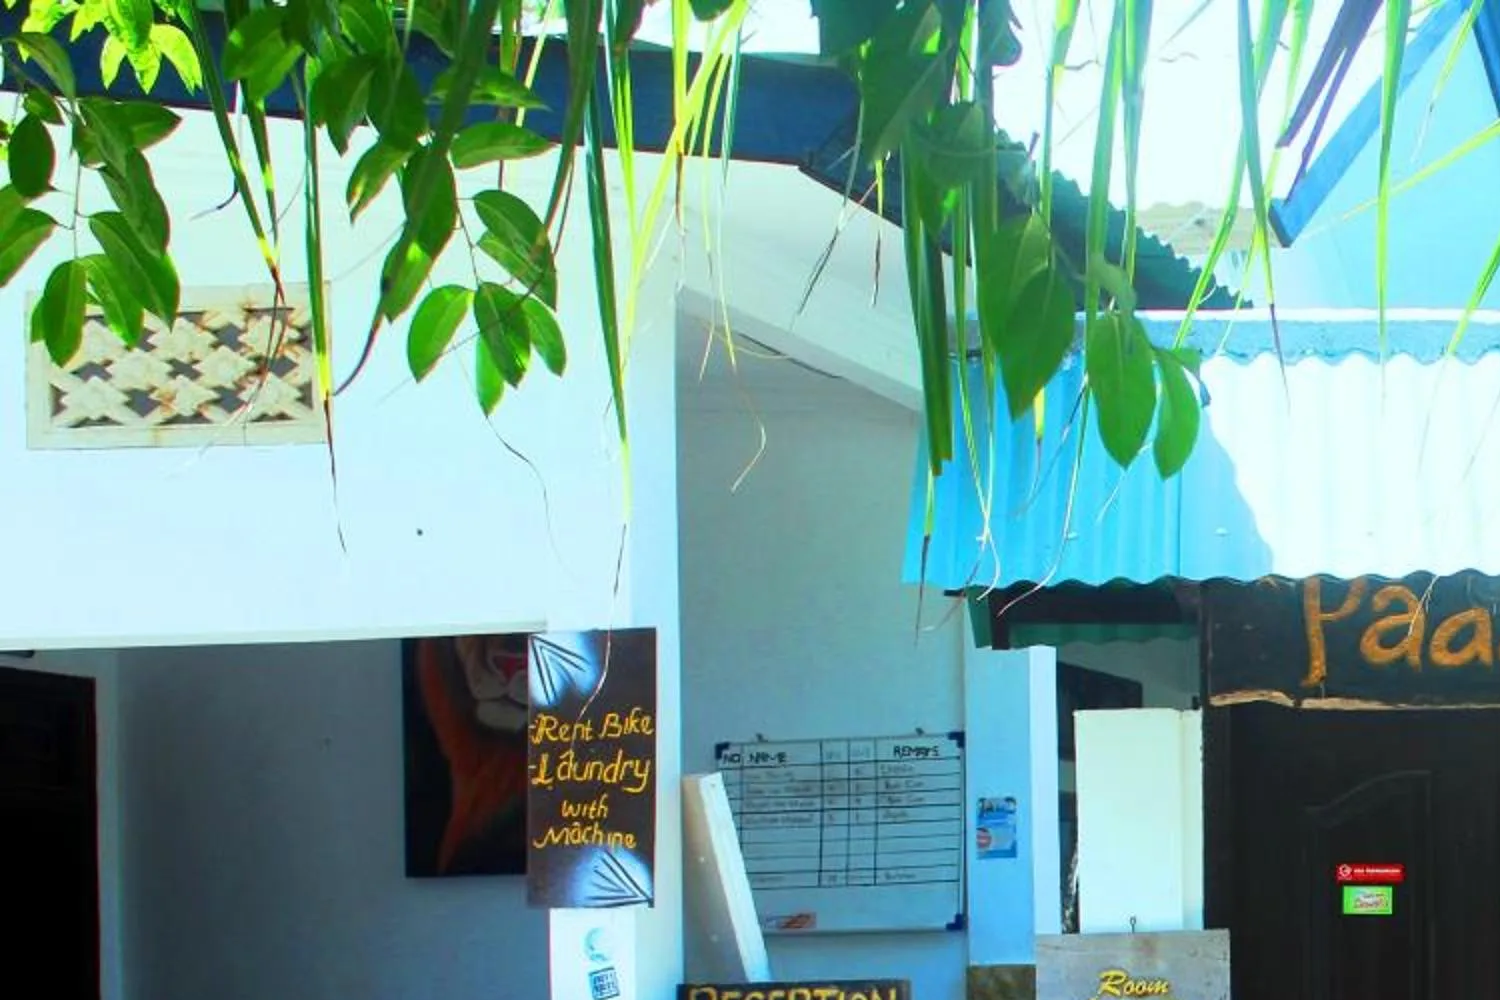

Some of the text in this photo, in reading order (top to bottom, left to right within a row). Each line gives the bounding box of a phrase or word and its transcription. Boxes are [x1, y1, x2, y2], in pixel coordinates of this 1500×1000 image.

[598, 706, 654, 740] Bike
[561, 793, 609, 819] with
[533, 822, 637, 849] Machine
[1098, 968, 1170, 997] Room
